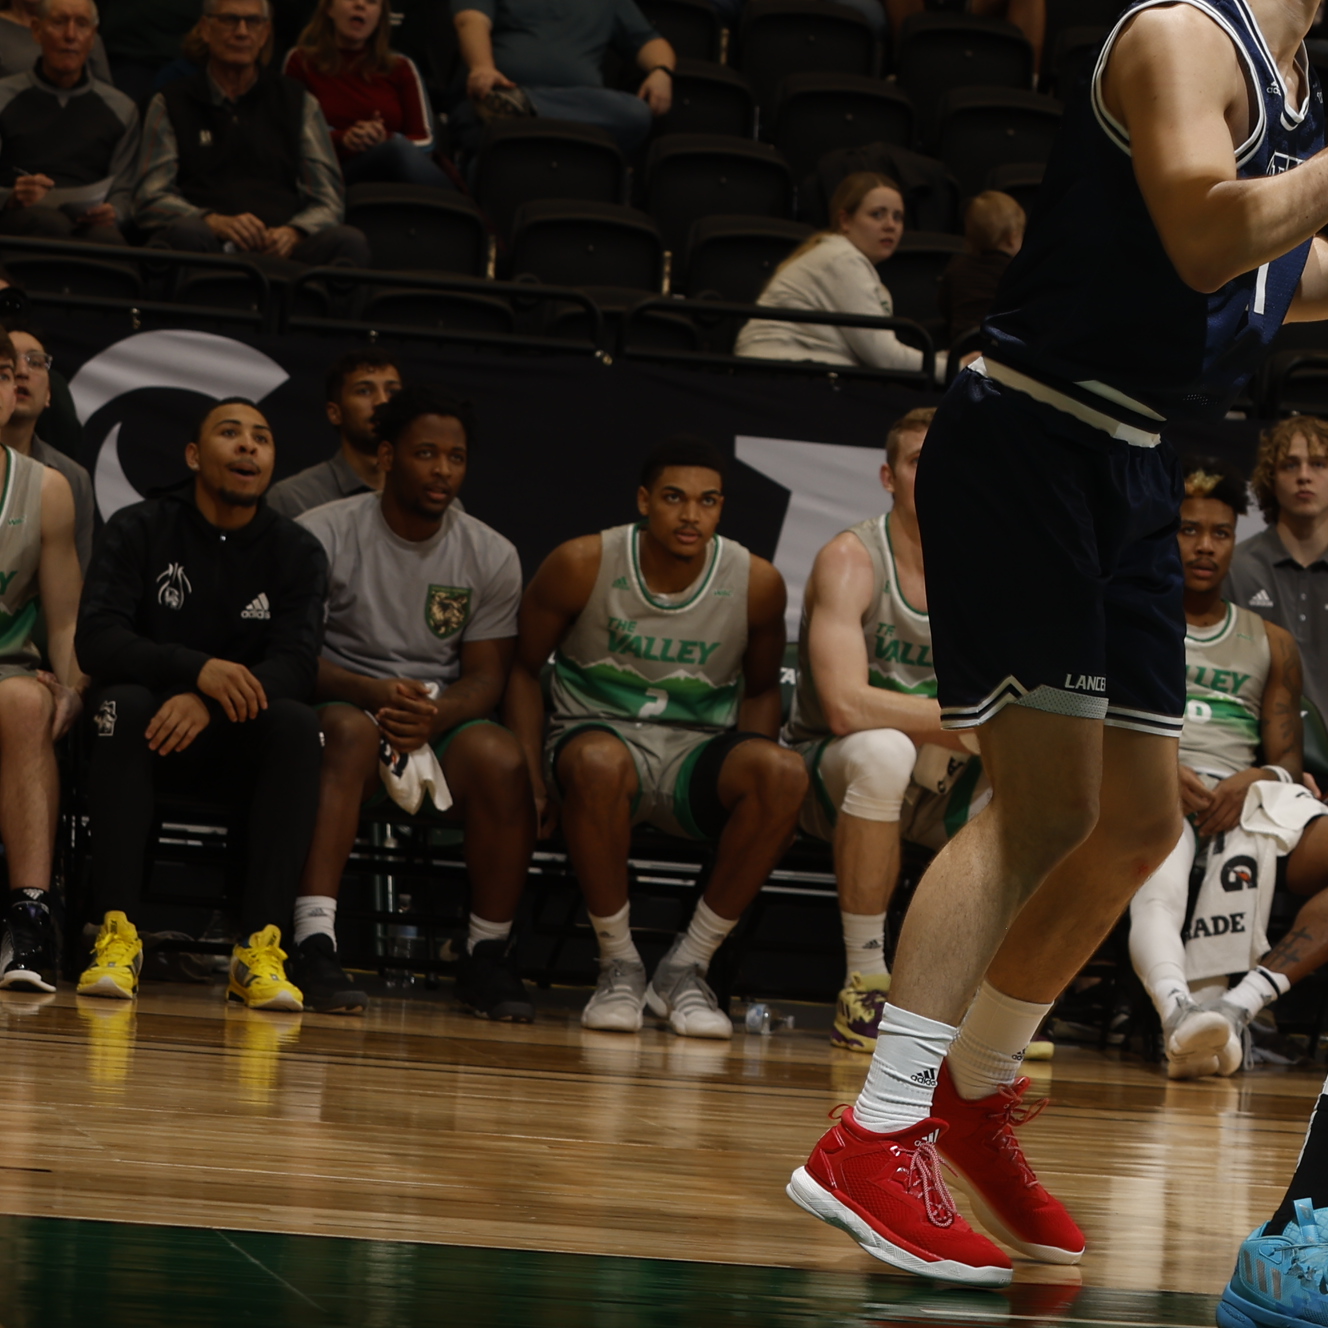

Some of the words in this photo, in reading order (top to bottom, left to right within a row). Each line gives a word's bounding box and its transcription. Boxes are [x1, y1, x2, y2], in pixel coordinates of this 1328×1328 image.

[240, 608, 272, 620] adidas
[607, 617, 637, 632] THE
[607, 629, 721, 665] VALLEY
[875, 635, 932, 667] VALL
[1194, 666, 1250, 694] LEY
[1221, 855, 1258, 892] G
